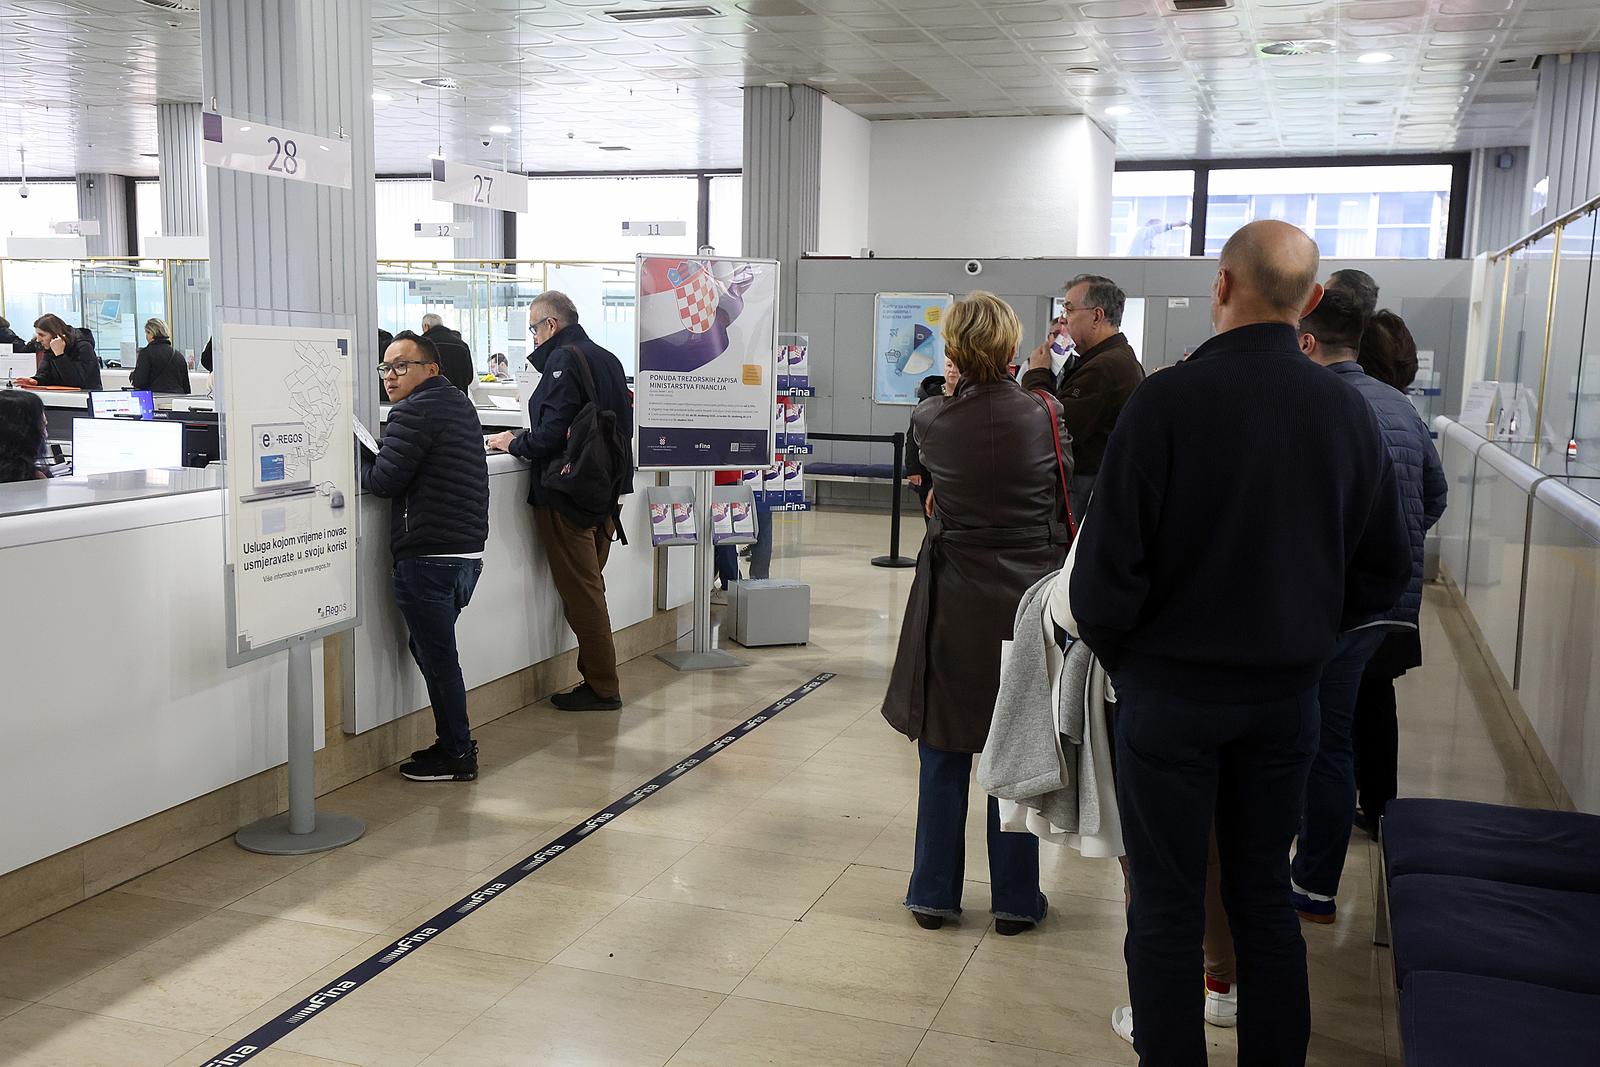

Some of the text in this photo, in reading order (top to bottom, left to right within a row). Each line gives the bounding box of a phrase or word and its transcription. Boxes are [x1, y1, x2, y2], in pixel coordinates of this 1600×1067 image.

[267, 136, 298, 174] 28
[473, 174, 493, 204] 27
[438, 225, 450, 236] 12
[648, 224, 660, 236] 11
[649, 374, 676, 382] PONUDA
[677, 375, 716, 383] TREZORSKIH
[649, 382, 727, 391] MINISTARSTVA FINANCIJA
[789, 387, 810, 396] Fina
[787, 445, 808, 454] Fina
[785, 502, 806, 511] Fina
[243, 527, 347, 554] Usluga kojom vrijeme i novac
[243, 540, 348, 571] usmjeravate u svoju korist
[325, 603, 347, 616] Regos
[676, 758, 700, 771] Fina
[633, 784, 660, 797] Fina
[586, 813, 615, 828] Fina
[533, 844, 566, 861] Fina
[471, 882, 508, 902] Fina
[397, 927, 439, 950] Fina
[309, 979, 357, 1006] Fina
